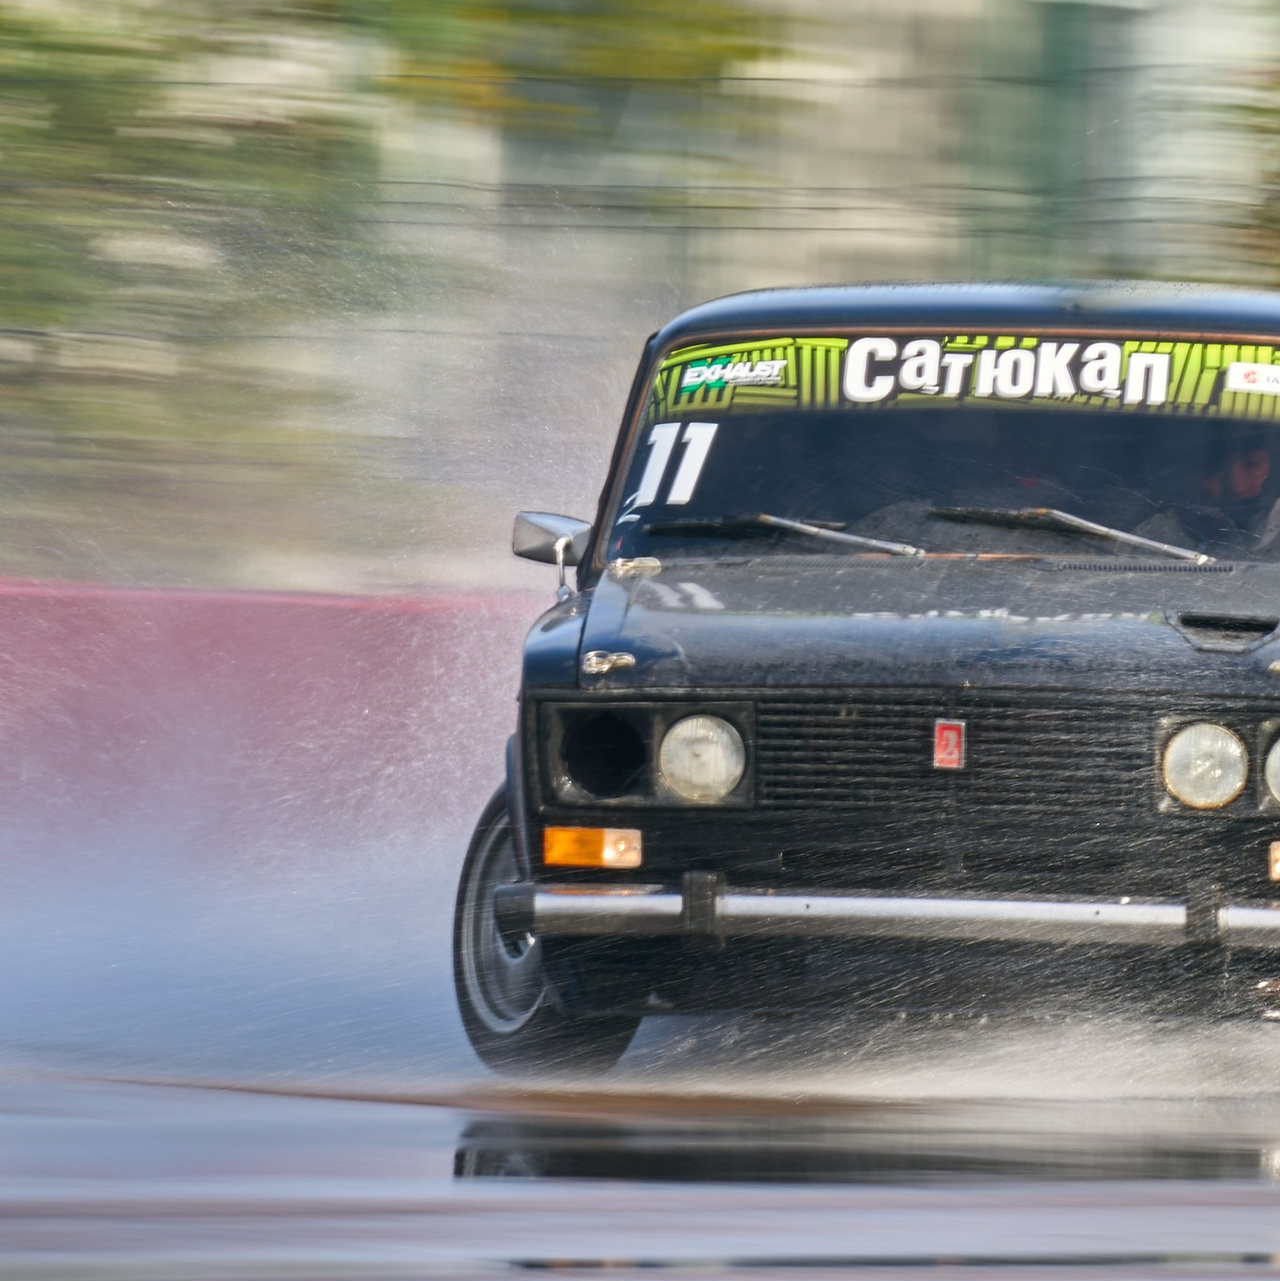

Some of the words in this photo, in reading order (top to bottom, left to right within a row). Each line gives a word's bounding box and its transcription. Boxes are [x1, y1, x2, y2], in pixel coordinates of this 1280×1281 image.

[681, 360, 787, 388] EXHAUST
[843, 337, 1171, 405] Сатюкап
[636, 422, 718, 506] 11
